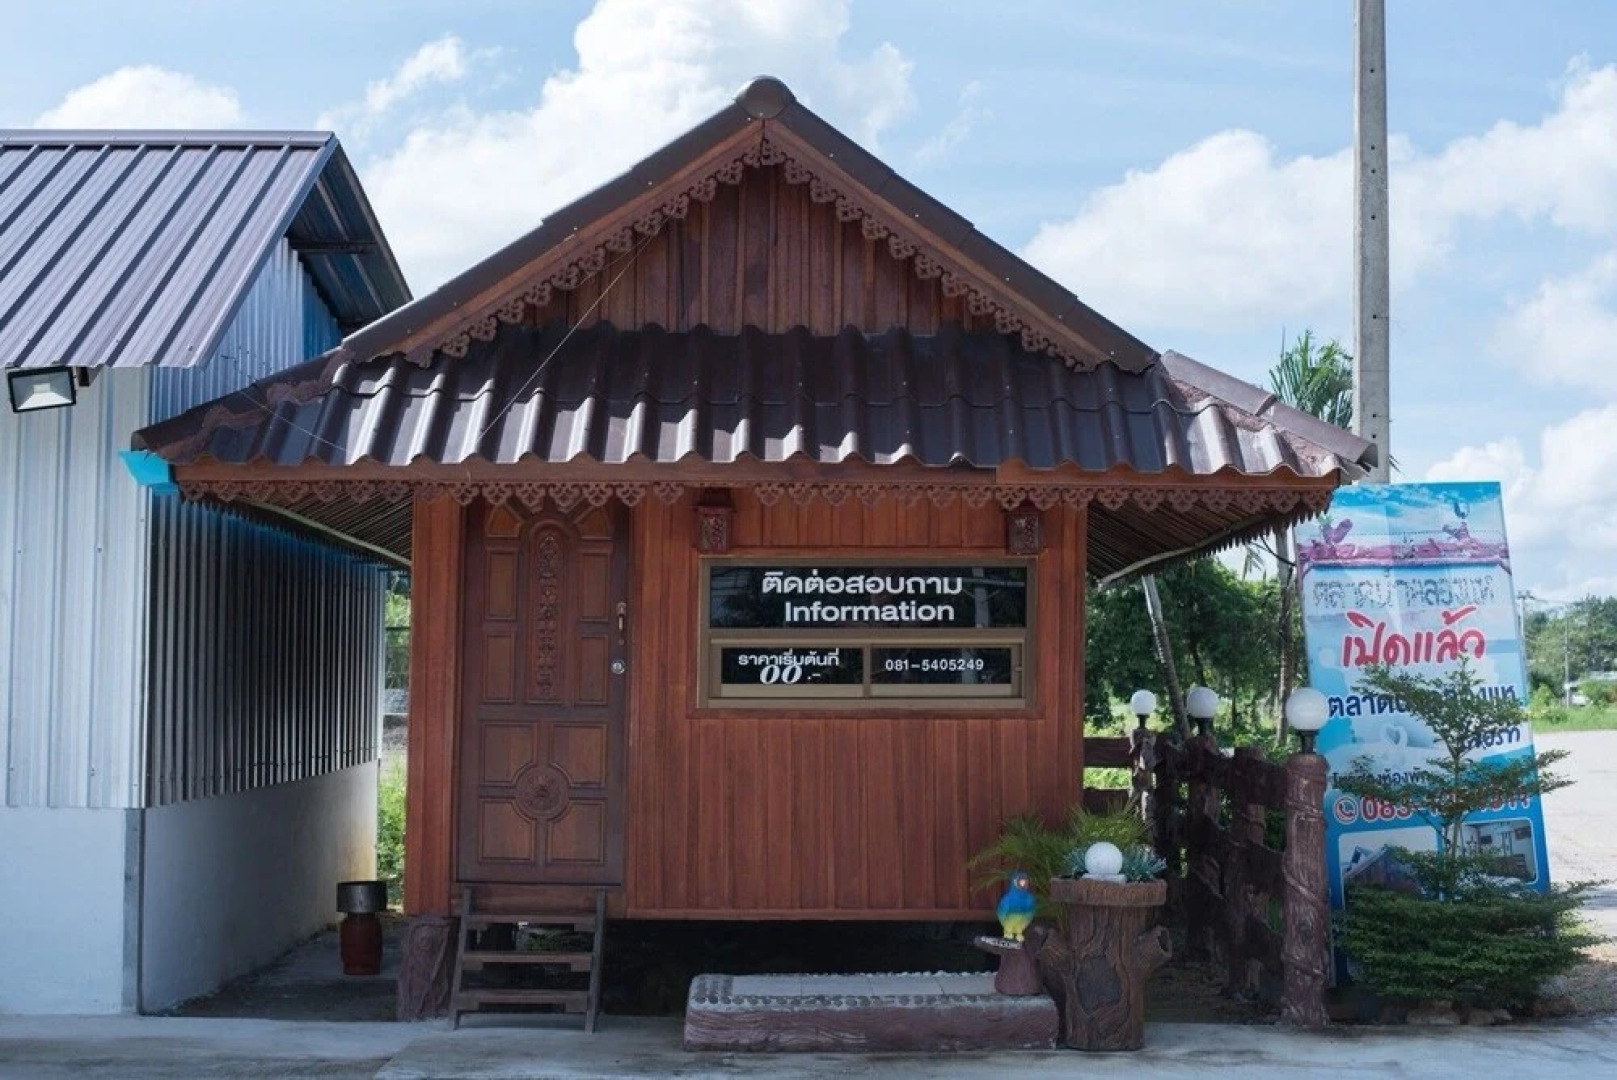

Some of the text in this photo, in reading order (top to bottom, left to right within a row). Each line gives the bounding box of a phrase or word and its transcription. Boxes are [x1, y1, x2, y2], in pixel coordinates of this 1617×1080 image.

[762, 569, 963, 595] ติดต่อสอบถาม
[785, 601, 955, 622] Information
[1343, 605, 1486, 668] เปิดแล้ว
[738, 648, 840, 666] ราคาเริ่มต้นที่
[885, 659, 984, 671] 081-5405249
